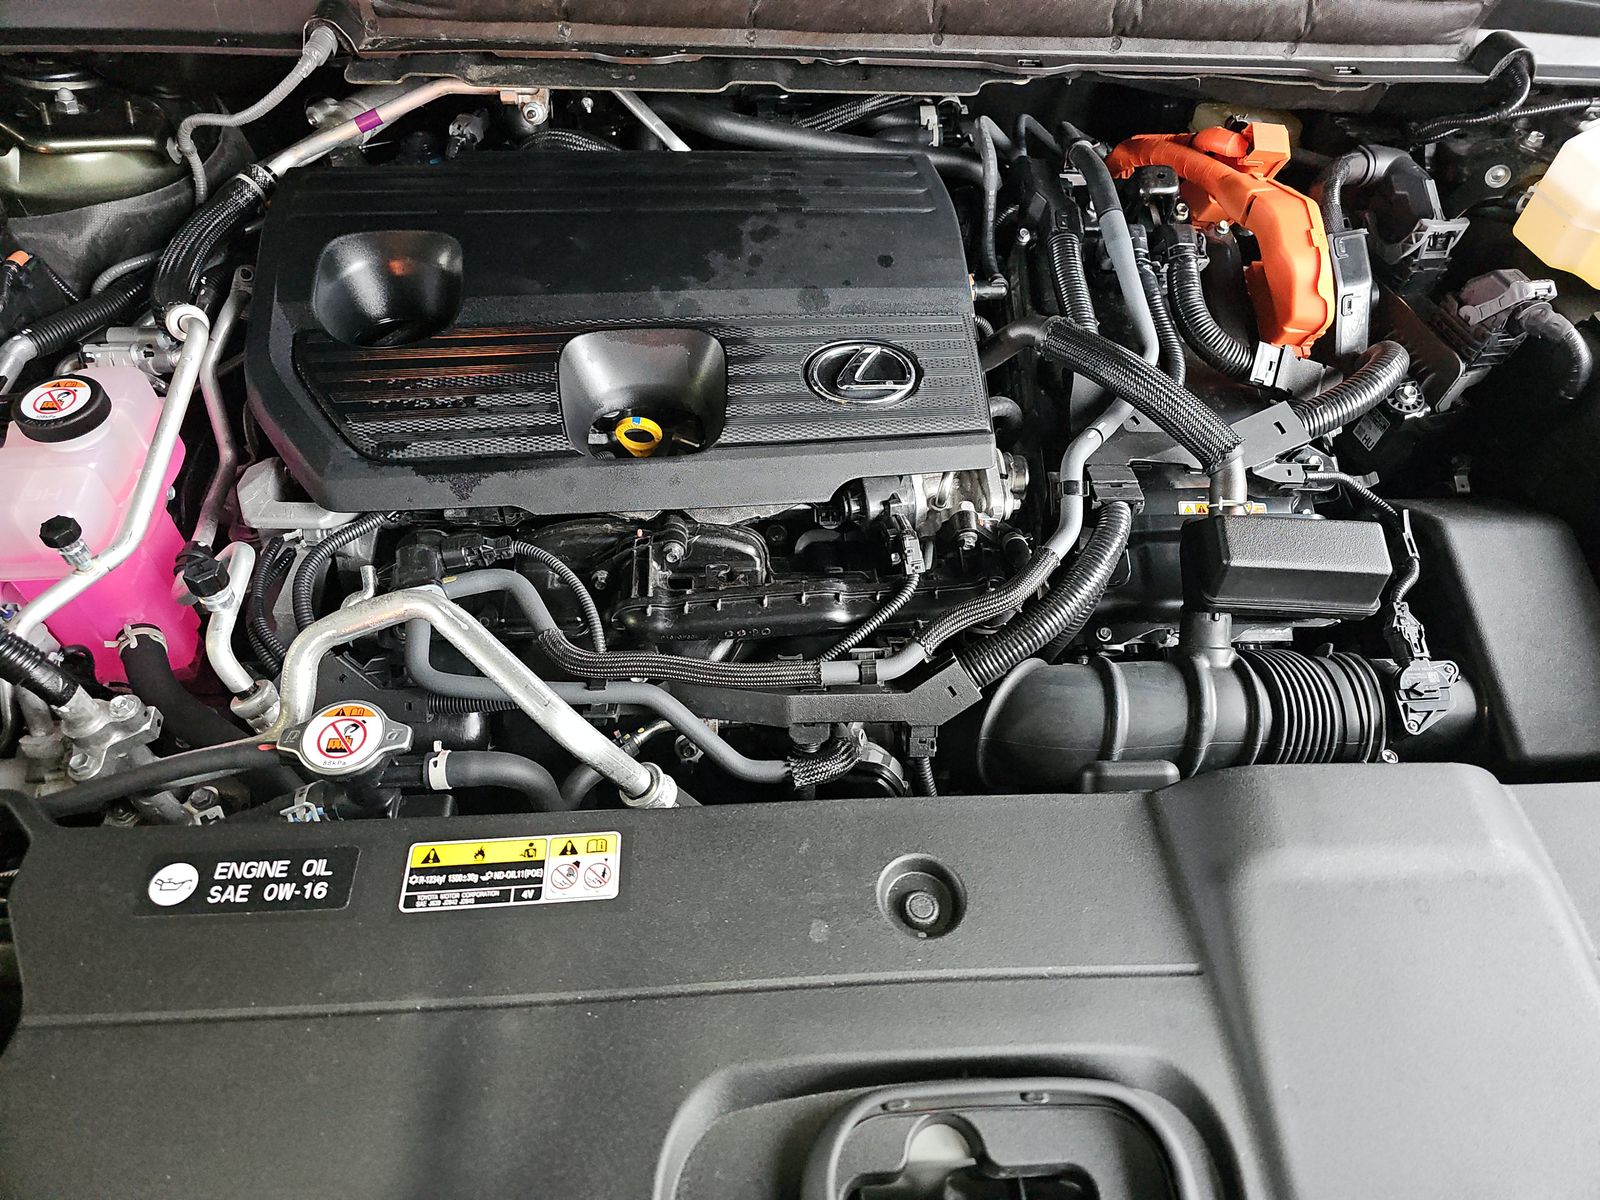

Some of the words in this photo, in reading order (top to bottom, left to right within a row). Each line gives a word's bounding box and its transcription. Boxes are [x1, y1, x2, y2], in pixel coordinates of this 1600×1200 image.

[213, 860, 291, 880] ENGINE
[302, 859, 333, 877] OIL
[207, 884, 252, 904] SAE
[263, 881, 329, 902] 0W-16
[461, 890, 500, 898] CORPORATION
[521, 889, 535, 899] 4V
